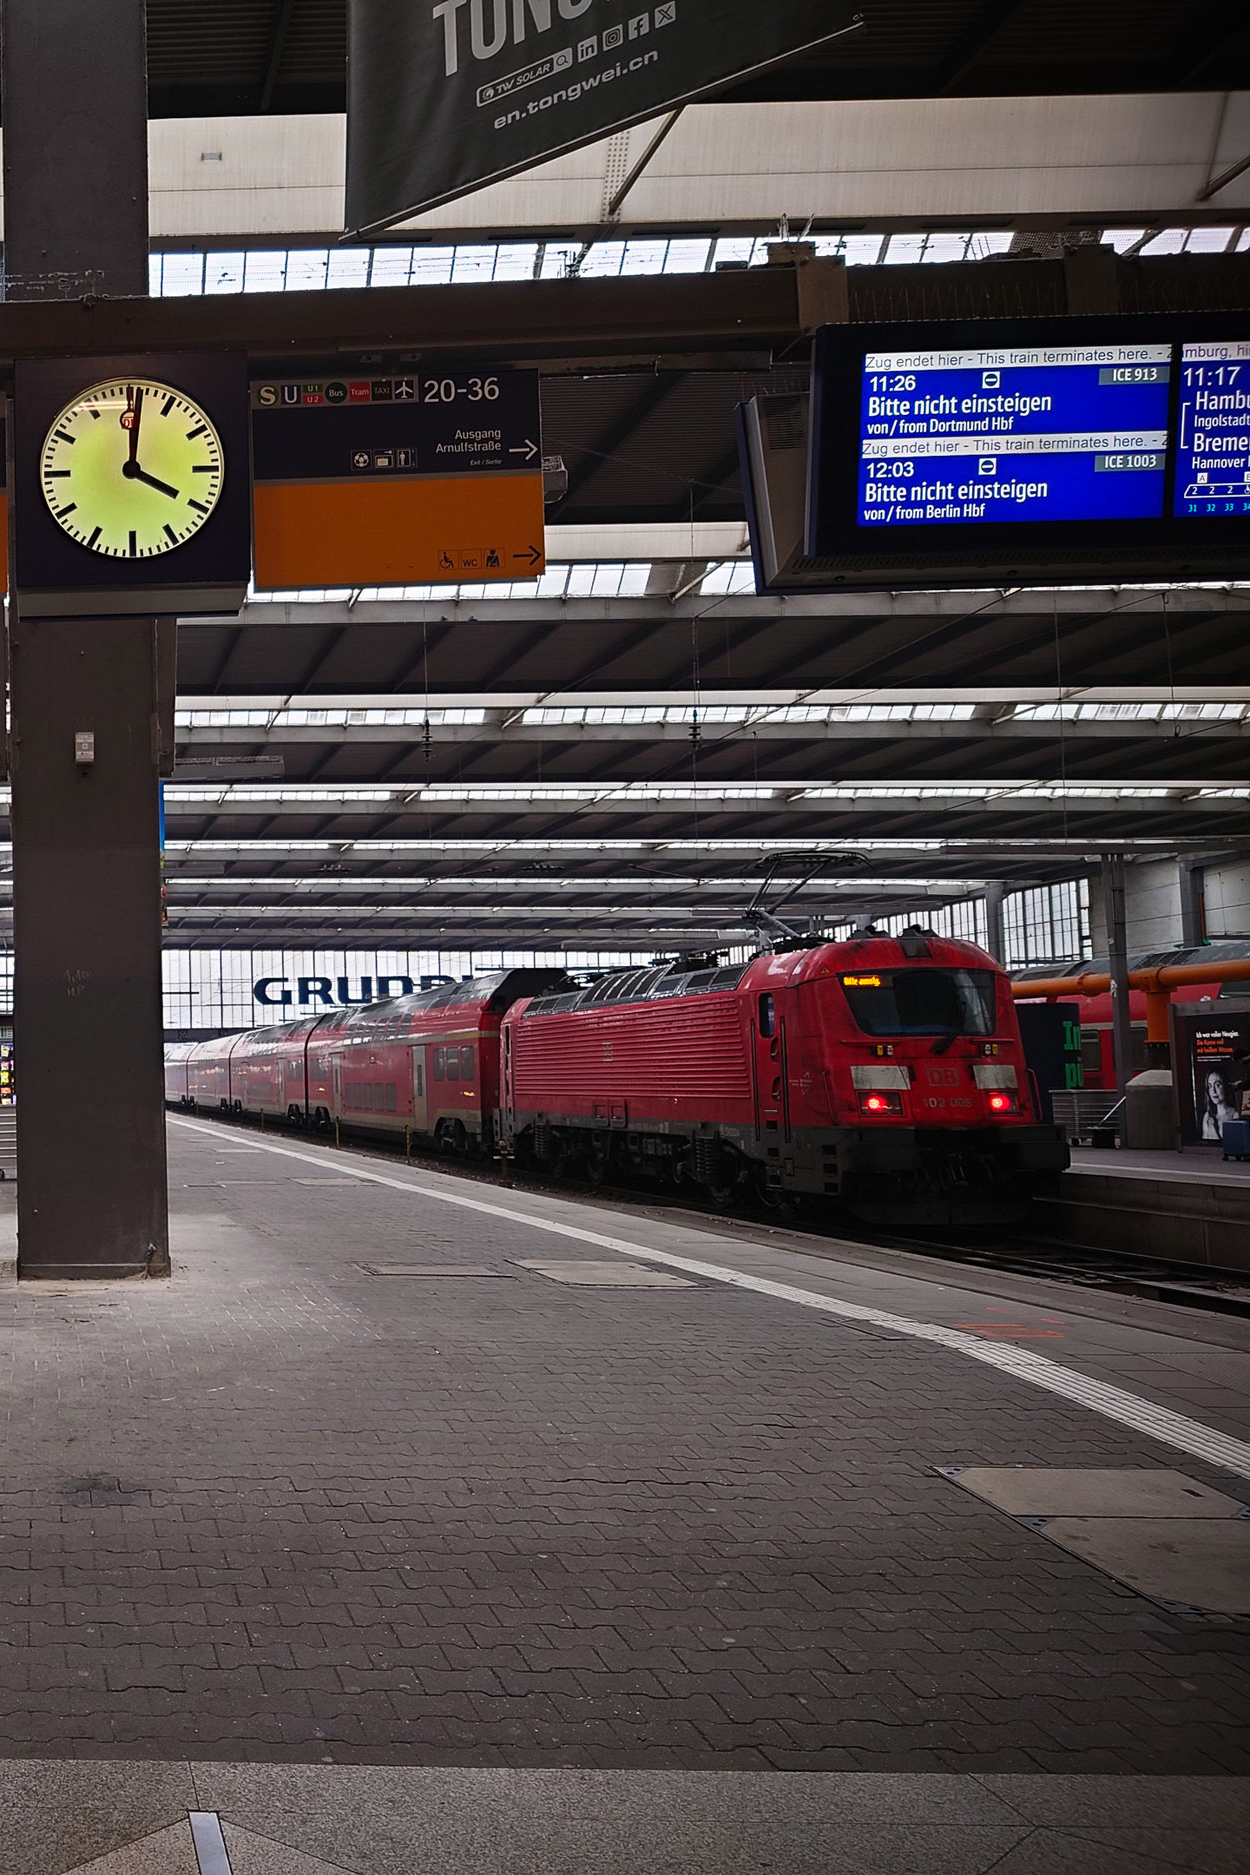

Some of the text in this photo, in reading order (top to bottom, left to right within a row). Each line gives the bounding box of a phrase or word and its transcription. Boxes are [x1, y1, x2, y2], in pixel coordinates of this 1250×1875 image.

[516, 63, 550, 85] SOLAR
[494, 50, 659, 129] en.tongwei.cn
[866, 348, 1152, 370] Zug endet hier This train terminates here.
[870, 375, 916, 392] 11:26
[1113, 368, 1157, 381] ICE 913
[1183, 366, 1241, 387] 11:17
[260, 386, 297, 405] S U
[351, 388, 369, 396] Tram
[374, 387, 390, 395] TAXI
[424, 377, 500, 403] 20-36
[869, 392, 1052, 416] Bitte nicht einsteigen
[455, 429, 501, 440] Ausgang
[867, 416, 1015, 435] von from Dortmund Hbf
[436, 440, 501, 453] Arnulfstraße
[862, 436, 1147, 457] Zug endet hier This train terminates here.
[1193, 433, 1250, 452] Breme
[866, 461, 914, 478] 12:03
[1104, 455, 1156, 468] ICE 1003
[1192, 456, 1245, 470] Hannover
[865, 479, 1048, 502] Bitte nicht einsteigen
[864, 503, 986, 521] von from Berlin Hbf
[1188, 504, 1197, 512] 31
[1206, 504, 1216, 512] 32
[1224, 503, 1234, 511] 33
[463, 558, 477, 567] WC
[253, 975, 473, 1005] GRUN
[928, 1068, 958, 1085] DB
